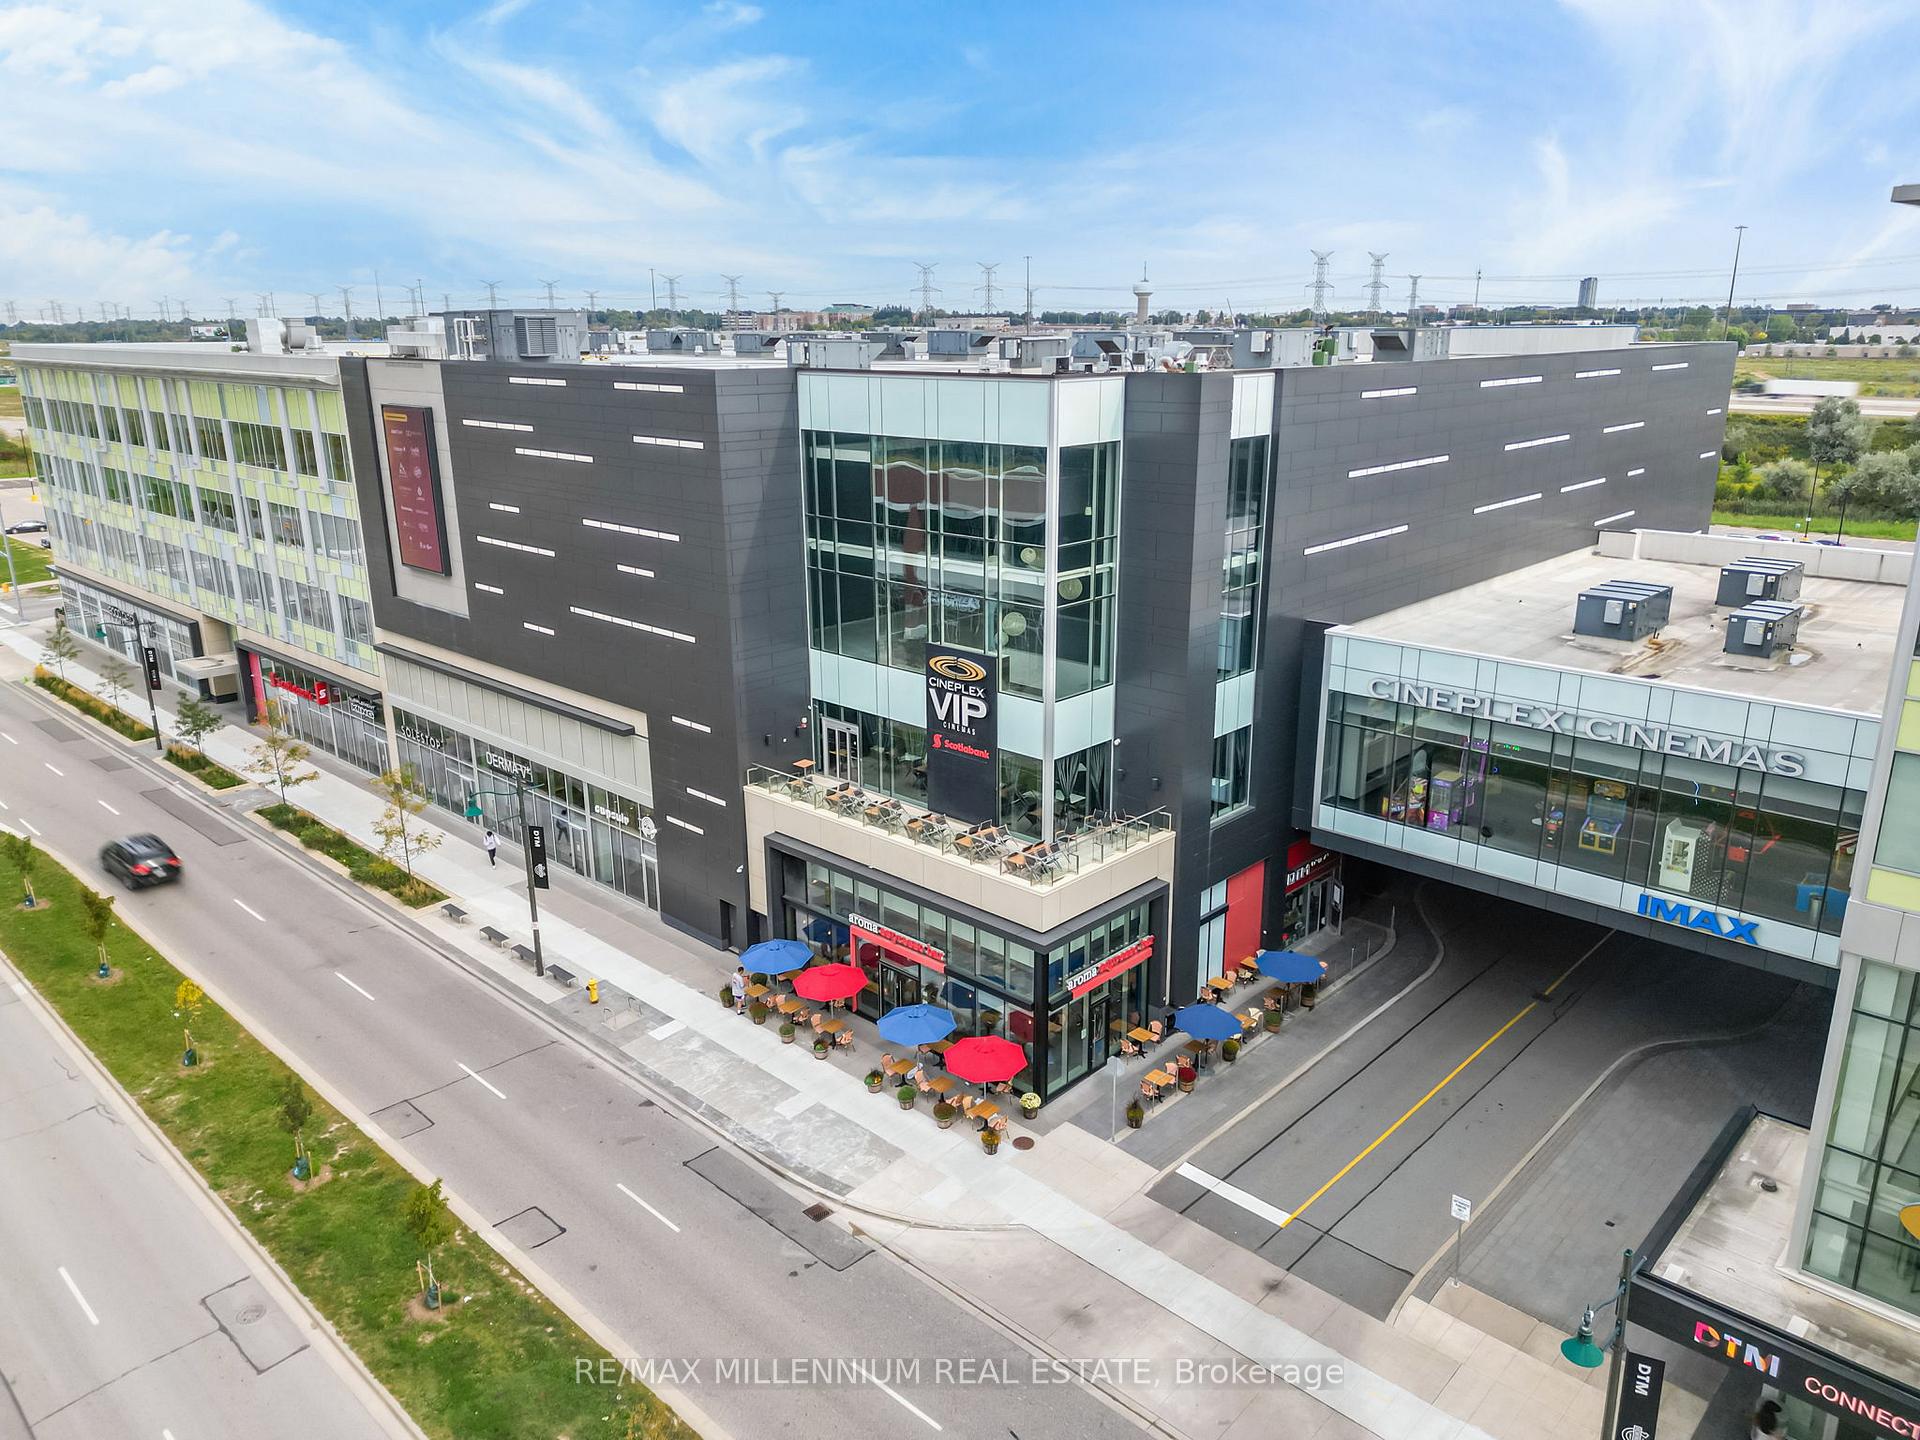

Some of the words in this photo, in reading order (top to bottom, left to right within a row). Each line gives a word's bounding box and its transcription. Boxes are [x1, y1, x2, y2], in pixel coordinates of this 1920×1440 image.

[929, 677, 986, 698] CINEPLEX
[929, 688, 987, 727] VIP
[401, 725, 442, 750] SOLESTOP
[943, 721, 976, 736] CINEMAS
[1368, 678, 1567, 733] CINEPLEX
[1584, 717, 1805, 777] CINEMAS
[944, 739, 990, 759] Scotiabank
[533, 830, 541, 848] DTM
[849, 913, 879, 934] aroma
[1637, 893, 1760, 945] IMAX
[1067, 966, 1098, 991] aroma
[1694, 1321, 1780, 1378] DTM
[1634, 1363, 1652, 1396] DTM
